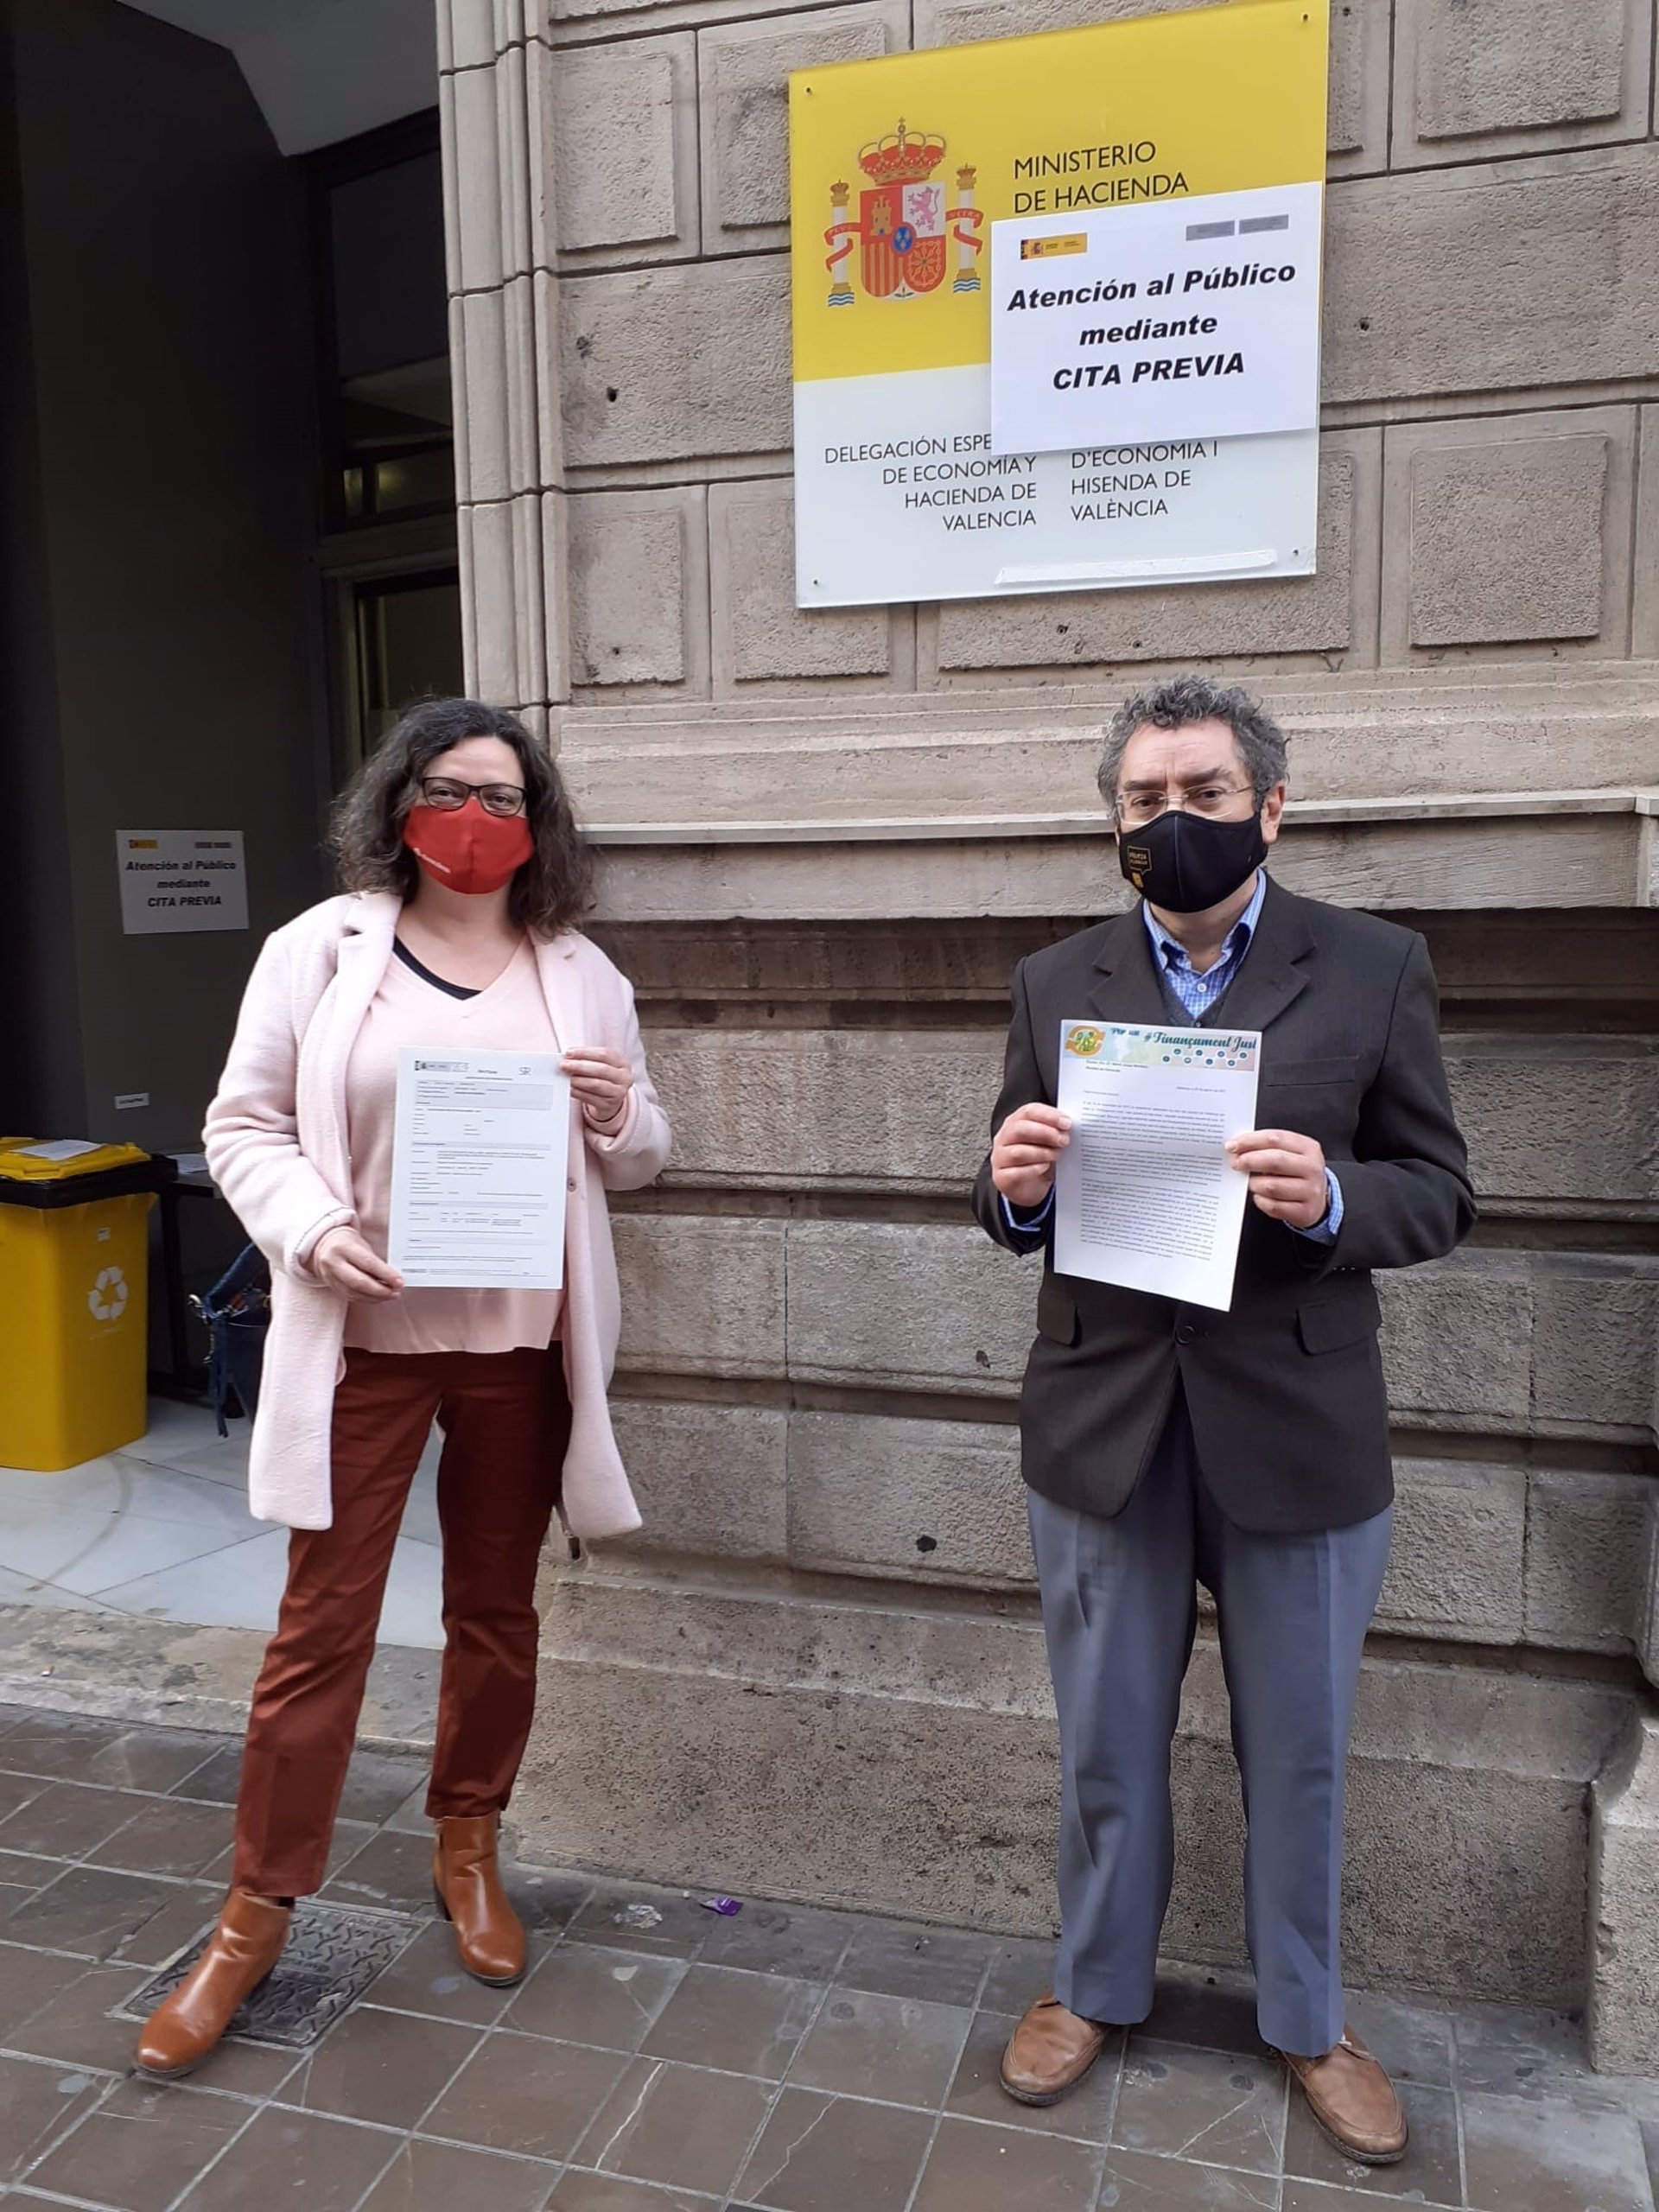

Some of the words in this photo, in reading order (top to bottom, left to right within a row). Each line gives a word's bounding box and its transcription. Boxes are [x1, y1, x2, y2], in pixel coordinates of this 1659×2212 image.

[1014, 141, 1156, 180] MINISTERIO
[1014, 189, 1046, 213] DE
[1055, 172, 1189, 209] HACIENDA
[1007, 279, 1136, 311] Atención
[1147, 273, 1174, 296] al
[1183, 264, 1296, 292] Público
[1079, 315, 1217, 346] mediante
[1053, 364, 1122, 390] CITA
[1132, 353, 1244, 383] PREVIA
[824, 435, 947, 464] DELEGACIÓN
[953, 434, 992, 453] ESPE
[1213, 440, 1218, 457] I
[882, 467, 907, 485] DE
[913, 454, 1022, 482] ECONOMÍA
[1026, 456, 1037, 472] Y
[1071, 473, 1158, 495] HISENDA
[1165, 469, 1192, 488] DE
[906, 485, 1005, 508] HACIENDA
[1011, 482, 1037, 500] DE
[943, 509, 1037, 531] VALENCIA
[1071, 498, 1169, 521] VALÈNCIA
[126, 861, 179, 871] Atención
[181, 861, 193, 871] al
[157, 879, 211, 889] mediante
[148, 897, 176, 907] CITA
[180, 896, 222, 906] PREVIA
